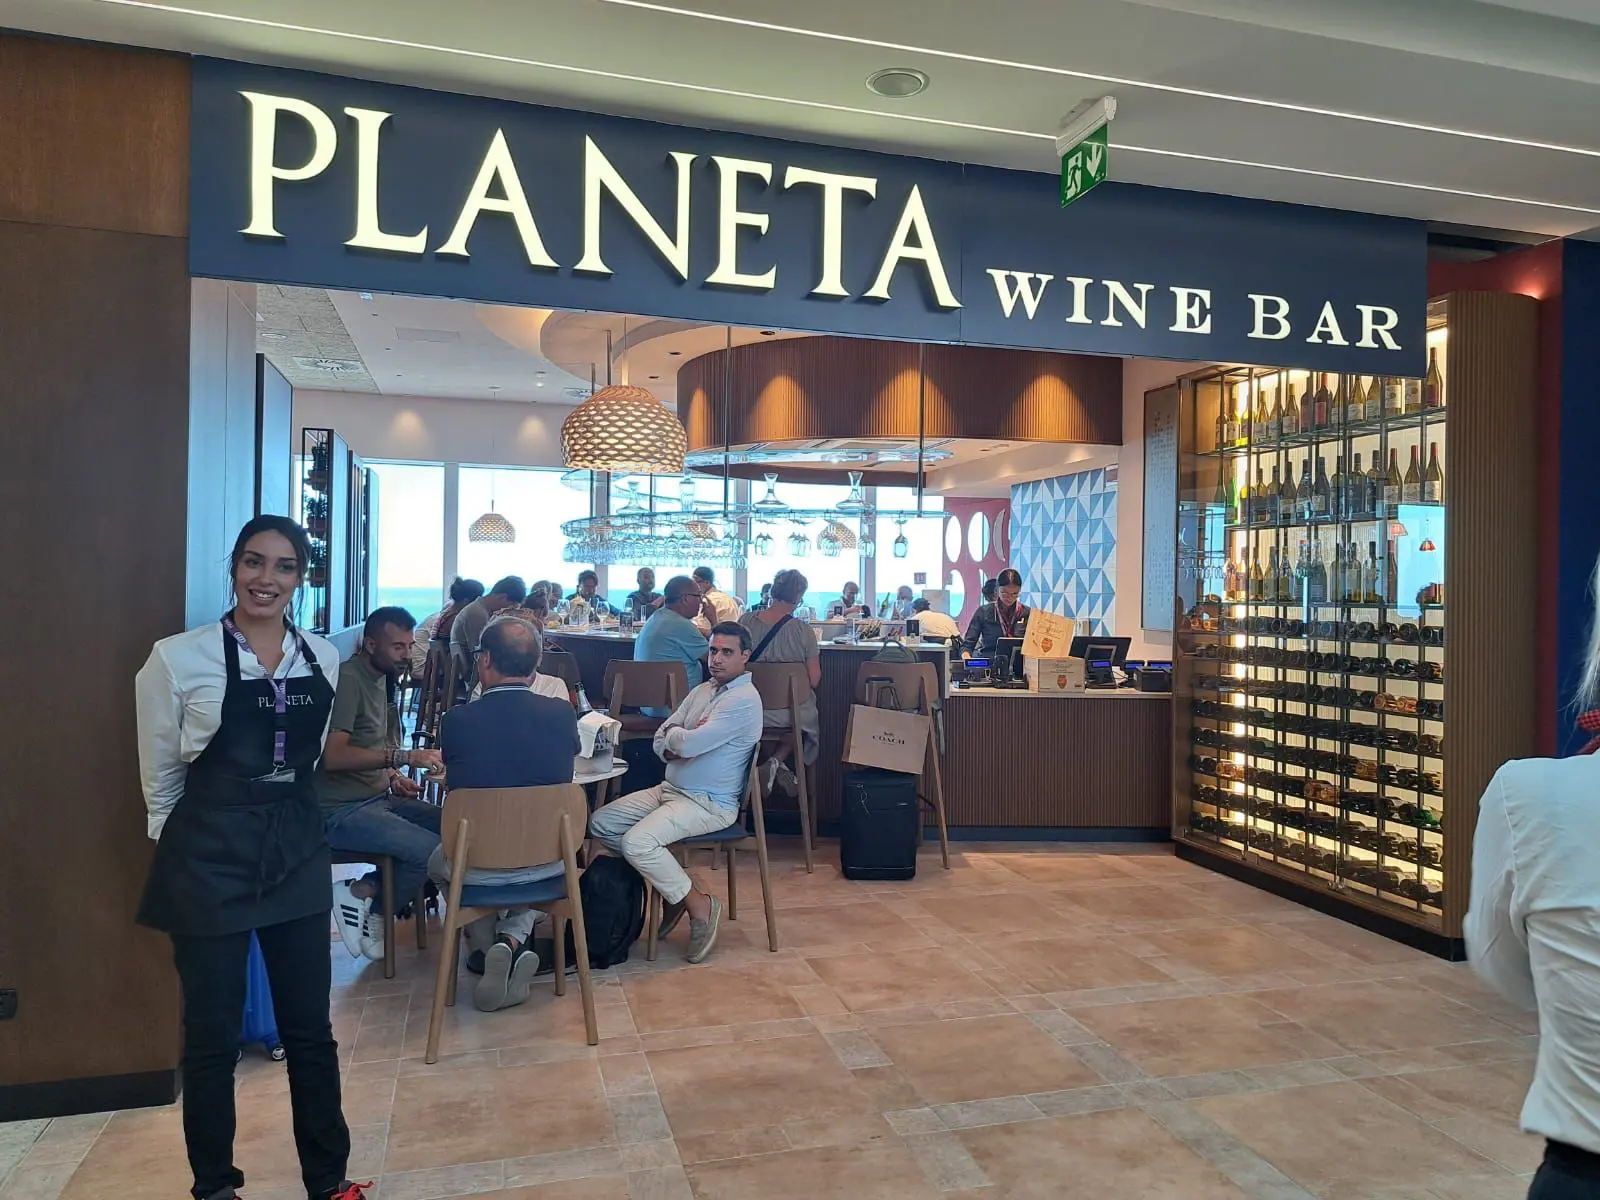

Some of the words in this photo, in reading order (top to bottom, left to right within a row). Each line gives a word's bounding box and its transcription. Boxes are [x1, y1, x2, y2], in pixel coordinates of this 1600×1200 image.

[237, 90, 963, 310] PLANETA
[986, 268, 1212, 335] WINE
[1247, 293, 1402, 351] BAR
[257, 694, 314, 708] PLNETA
